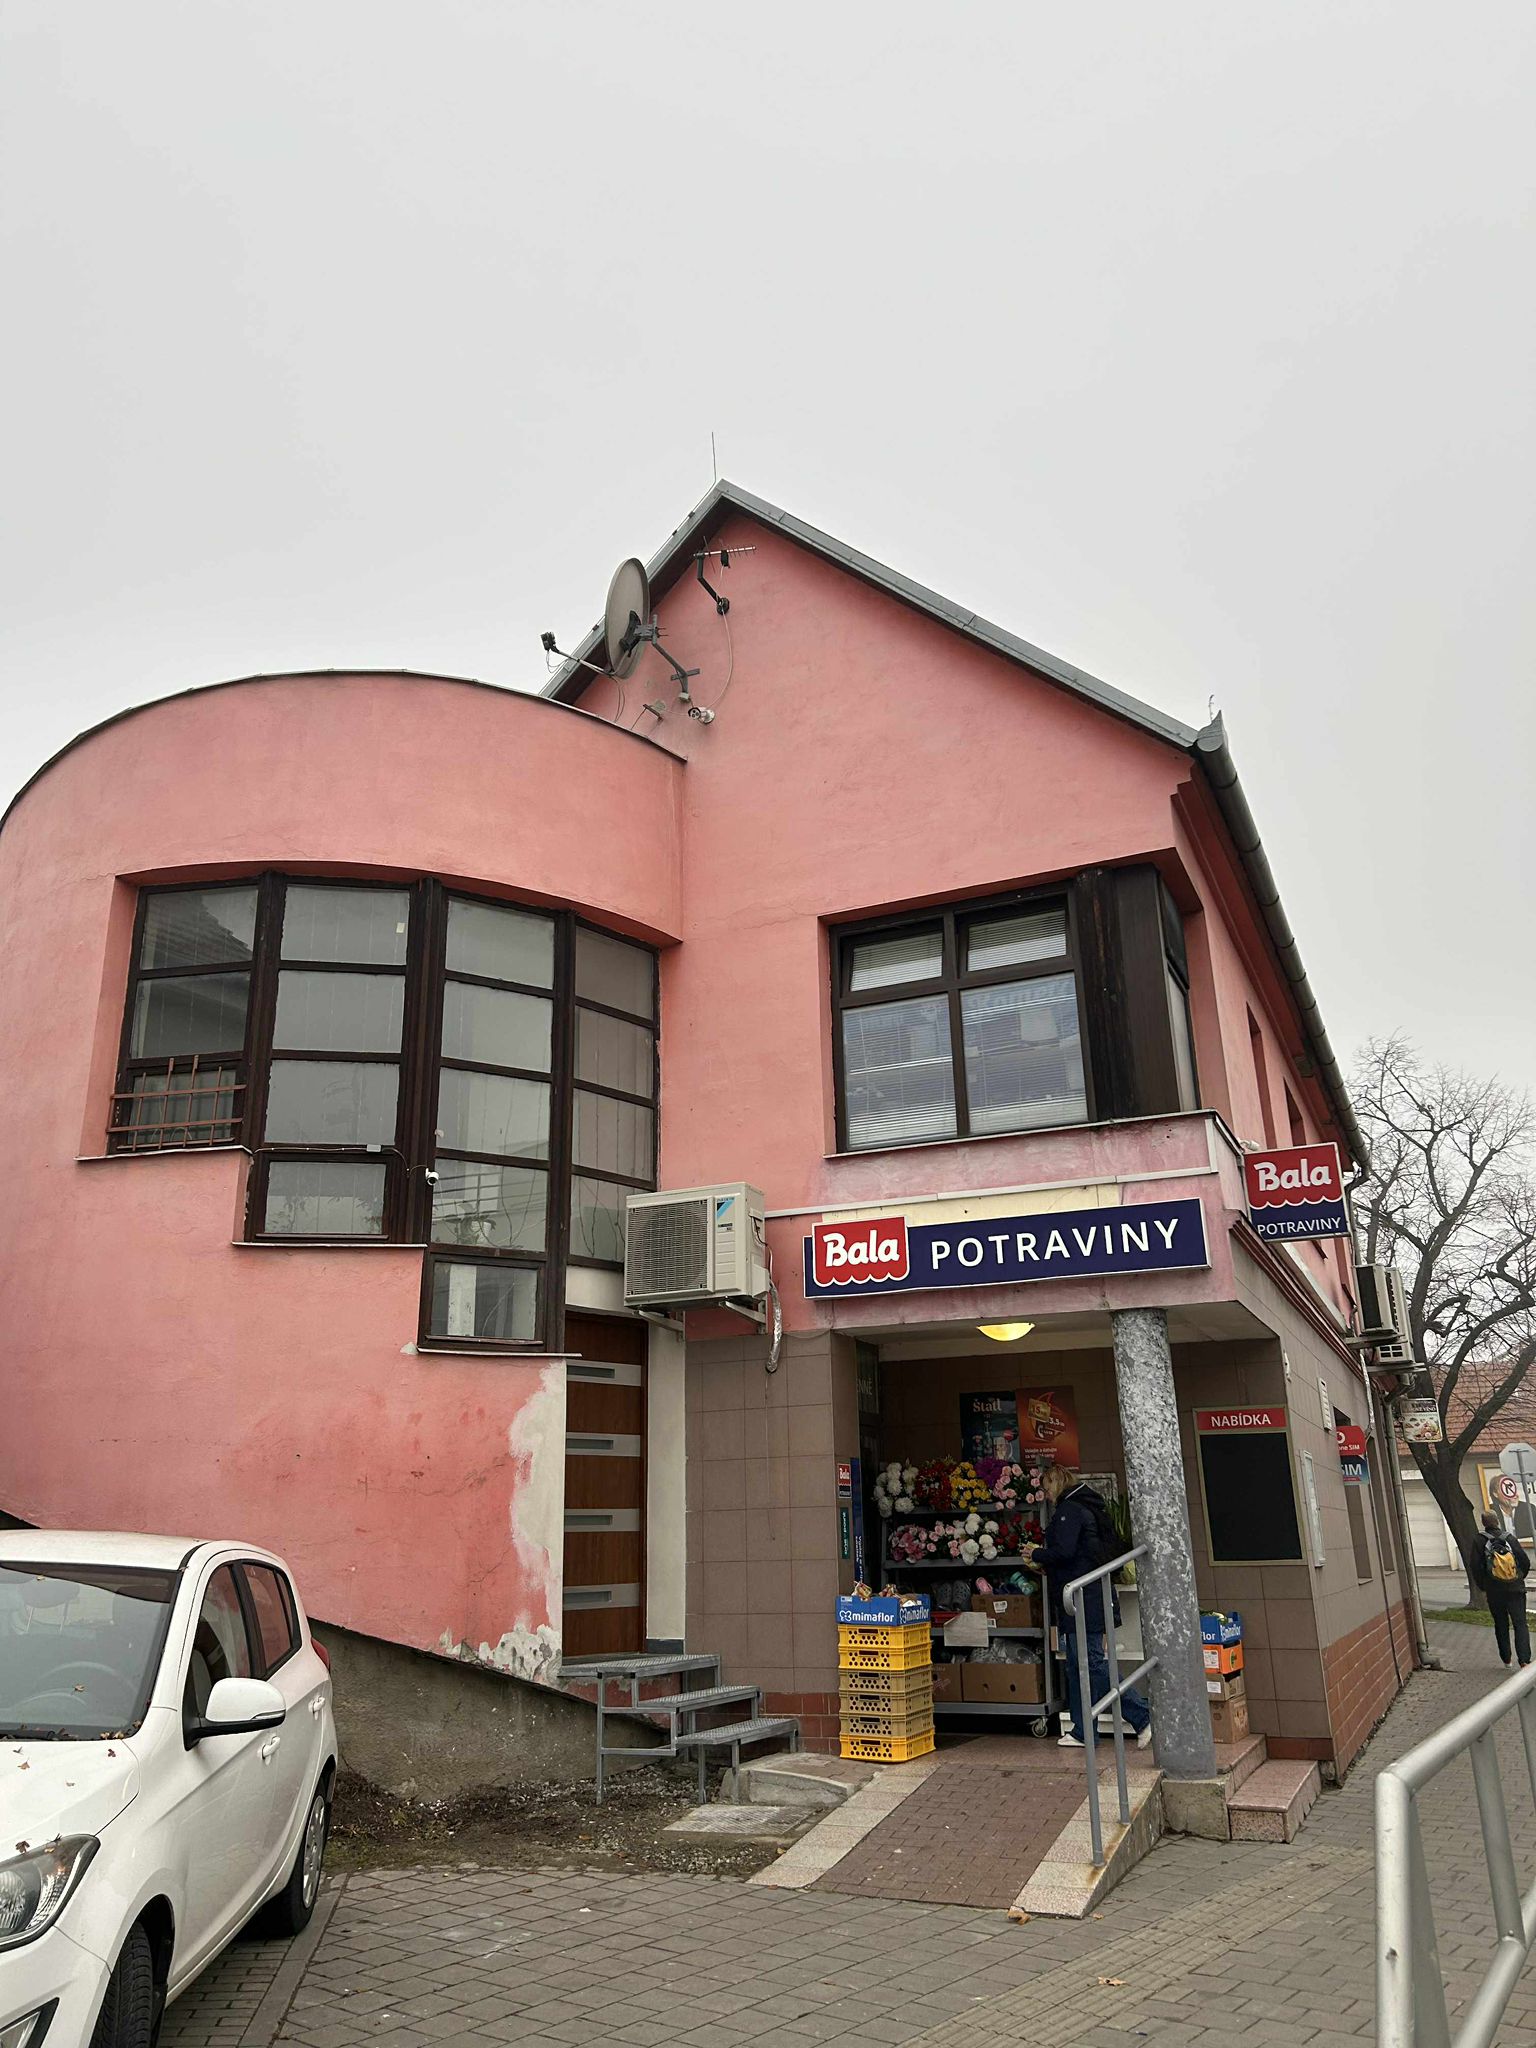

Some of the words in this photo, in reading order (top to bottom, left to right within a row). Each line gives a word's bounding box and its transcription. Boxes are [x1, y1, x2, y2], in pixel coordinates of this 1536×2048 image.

[1253, 1158, 1332, 1192] Bala
[1257, 1216, 1341, 1235] POTRAVINY
[823, 1229, 900, 1268] Bala
[931, 1218, 1179, 1270] POTRAVINY
[1211, 1412, 1272, 1427] NABÍDKA
[852, 1612, 895, 1623] mimaflor
